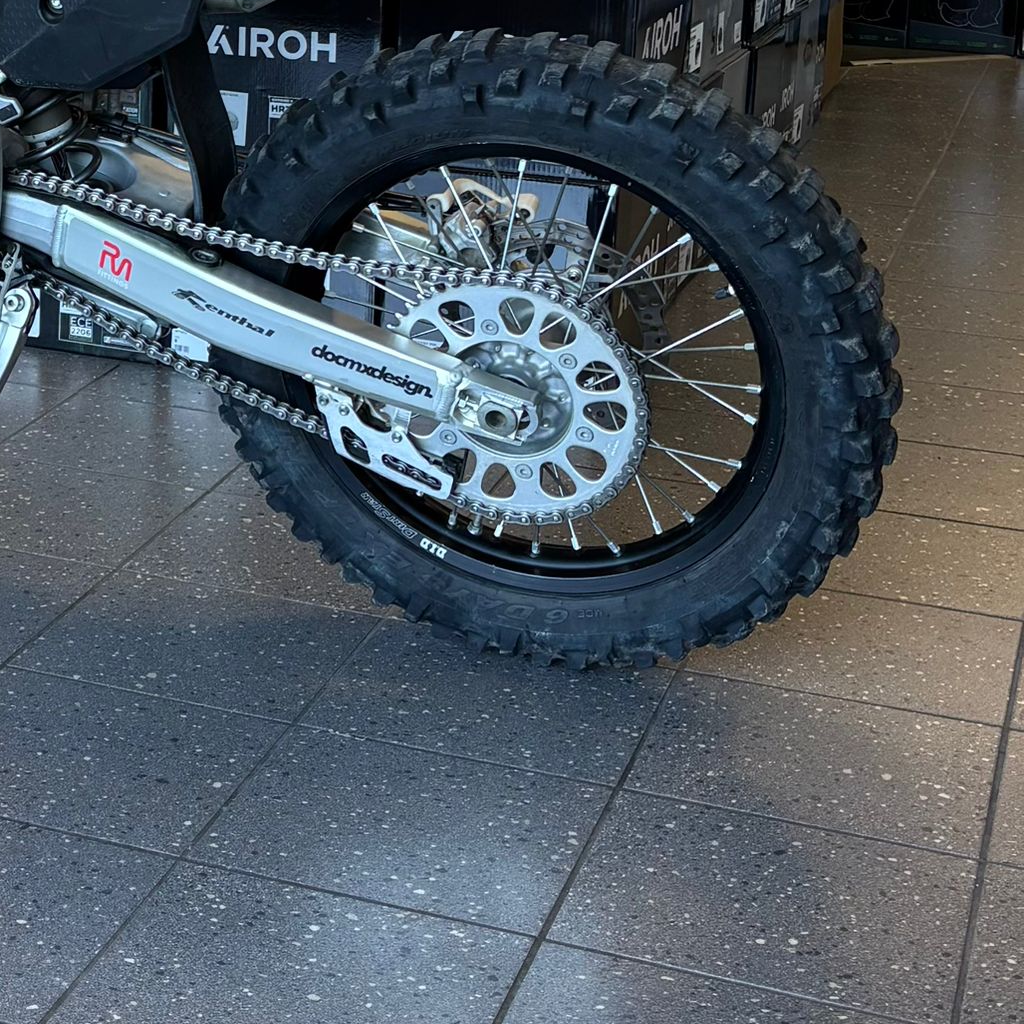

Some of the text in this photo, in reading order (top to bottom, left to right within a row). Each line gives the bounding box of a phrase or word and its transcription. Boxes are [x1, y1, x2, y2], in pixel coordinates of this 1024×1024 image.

[207, 25, 337, 63] AIROH
[642, 4, 683, 60] AIROH
[71, 317, 92, 328] ECE
[71, 327, 92, 337] 2206
